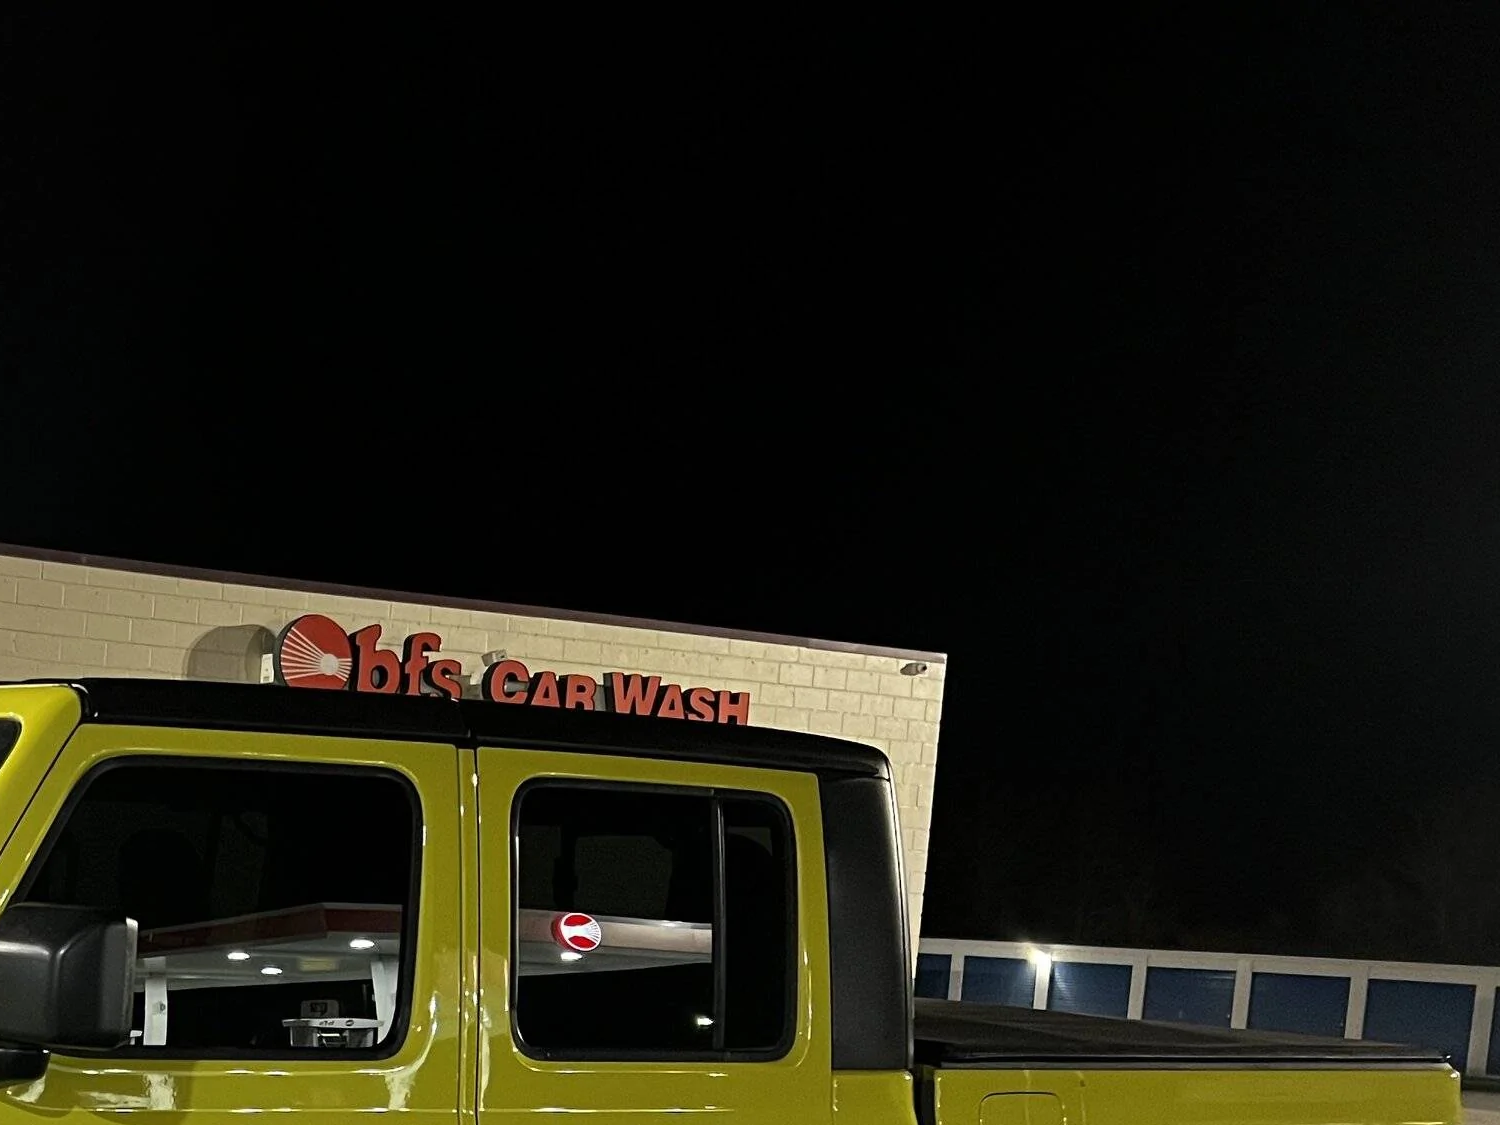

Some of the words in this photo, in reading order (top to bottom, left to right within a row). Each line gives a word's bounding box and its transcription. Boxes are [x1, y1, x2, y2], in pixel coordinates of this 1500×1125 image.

[353, 624, 462, 701] bfs
[484, 659, 596, 710] CAR
[605, 672, 750, 726] WASH
